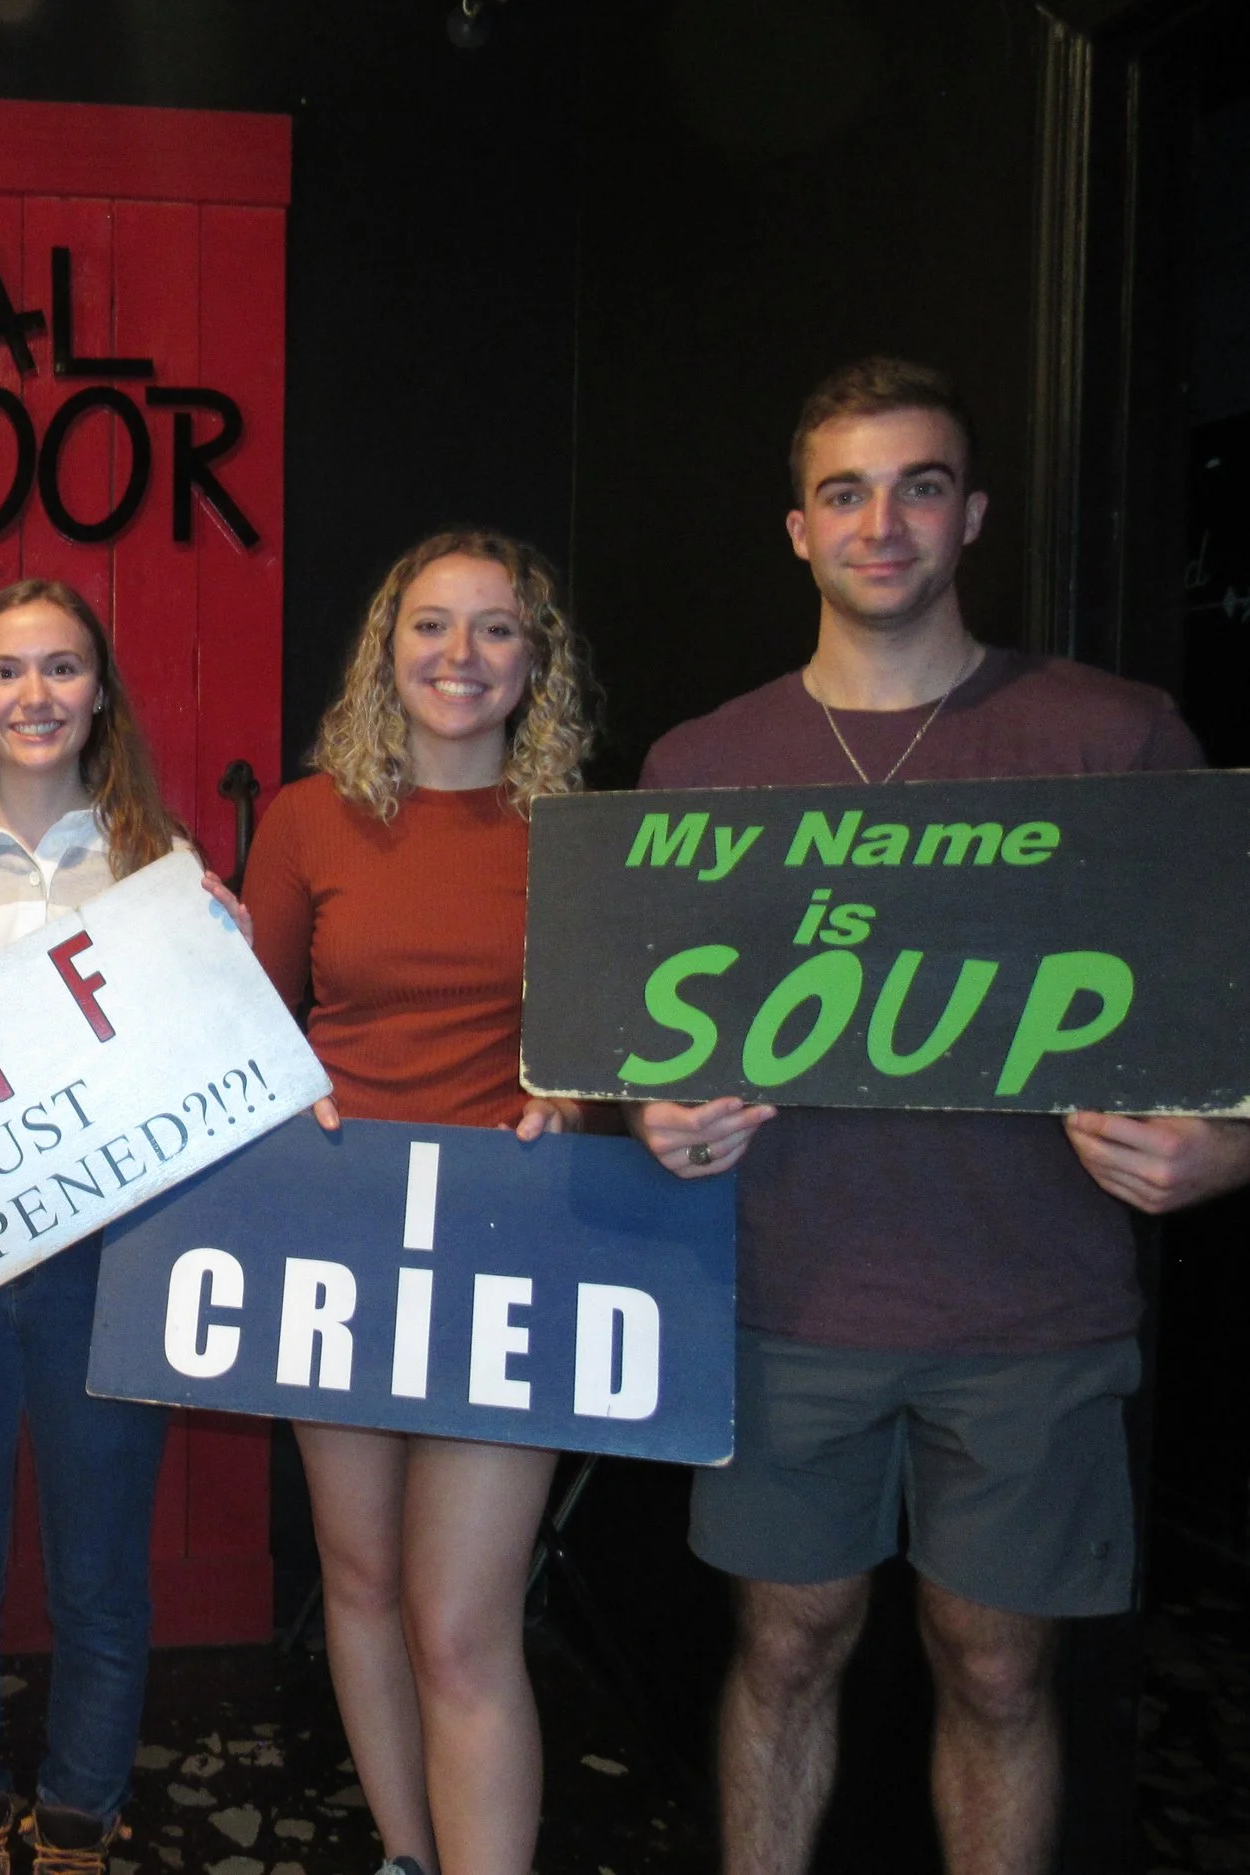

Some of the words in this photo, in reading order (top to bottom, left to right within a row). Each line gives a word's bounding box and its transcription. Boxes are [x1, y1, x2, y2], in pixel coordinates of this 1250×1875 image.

[625, 812, 764, 882] My
[784, 810, 1062, 868] Name
[792, 888, 877, 946] is
[617, 944, 1135, 1097] SOUP
[403, 1141, 440, 1250] I
[163, 1247, 661, 1420] CRIED
